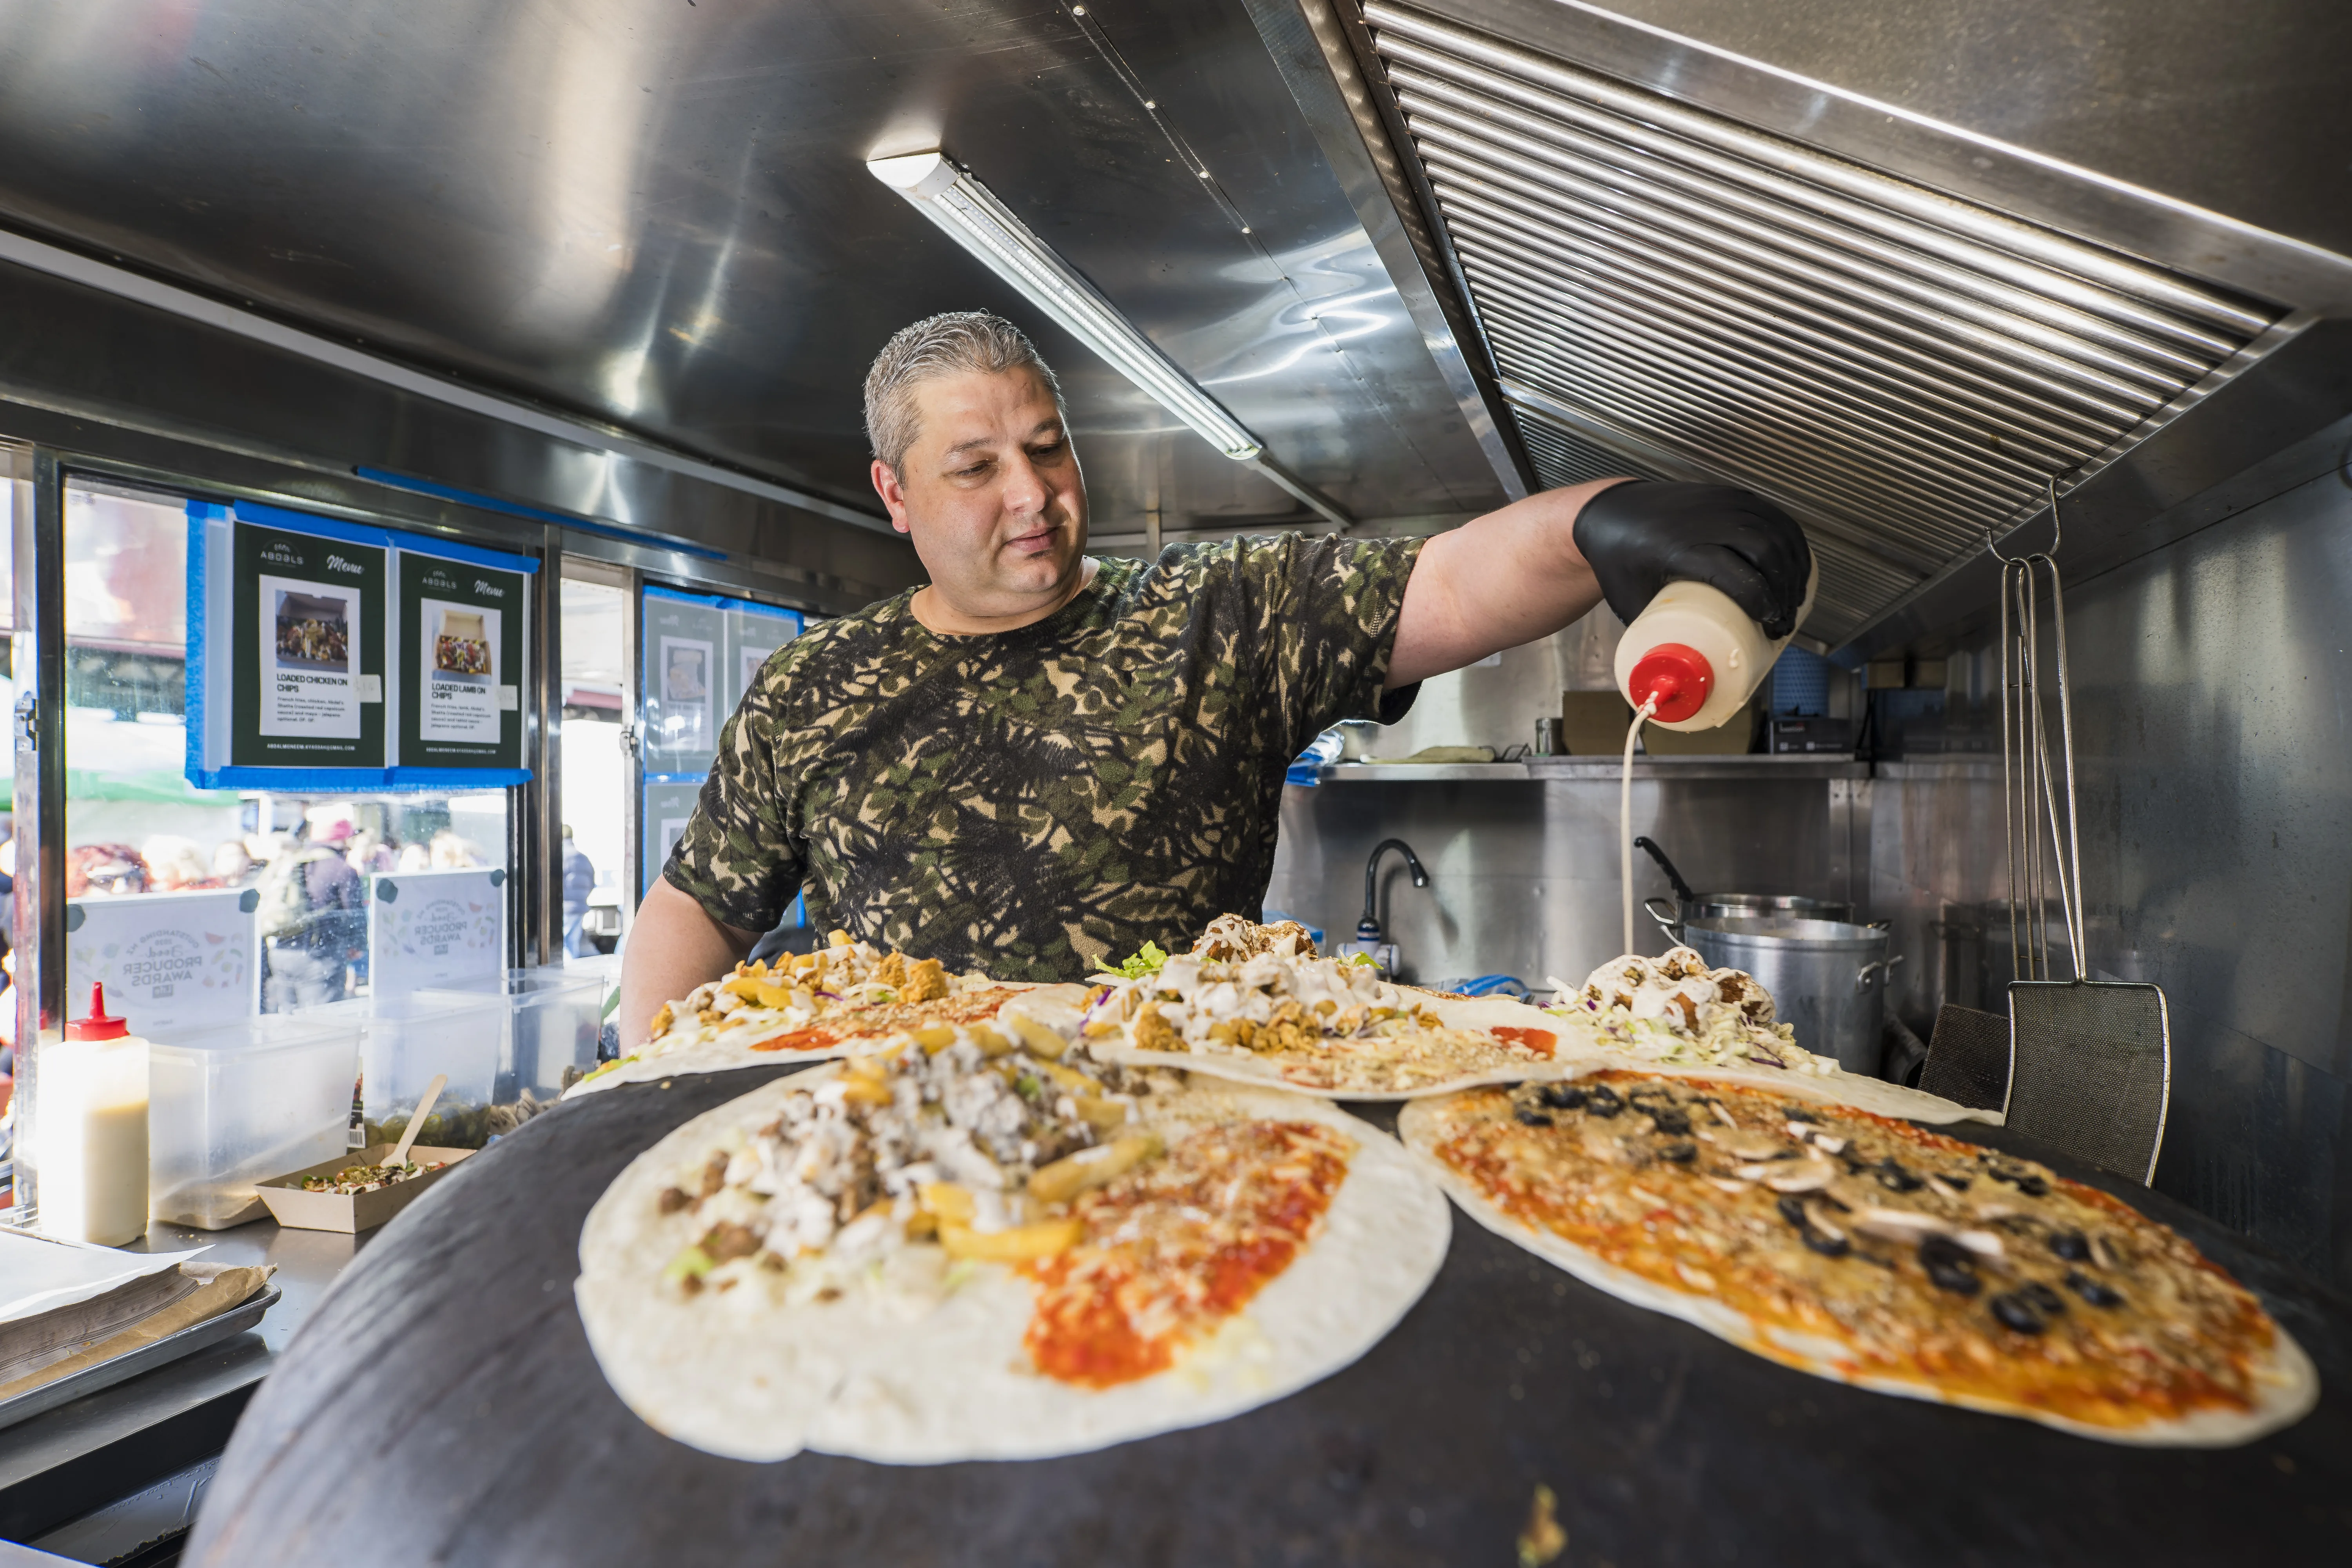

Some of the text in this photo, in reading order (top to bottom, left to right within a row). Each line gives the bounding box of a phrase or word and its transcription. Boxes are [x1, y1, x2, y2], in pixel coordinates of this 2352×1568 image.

[327, 554, 365, 575] Menu
[474, 579, 505, 598] Menu
[276, 673, 348, 686] LOADED CHICKEN ON
[277, 683, 299, 693] CHIPS
[432, 682, 458, 692] LOADED
[459, 684, 476, 694] LAMB
[432, 691, 452, 700] CHIPS
